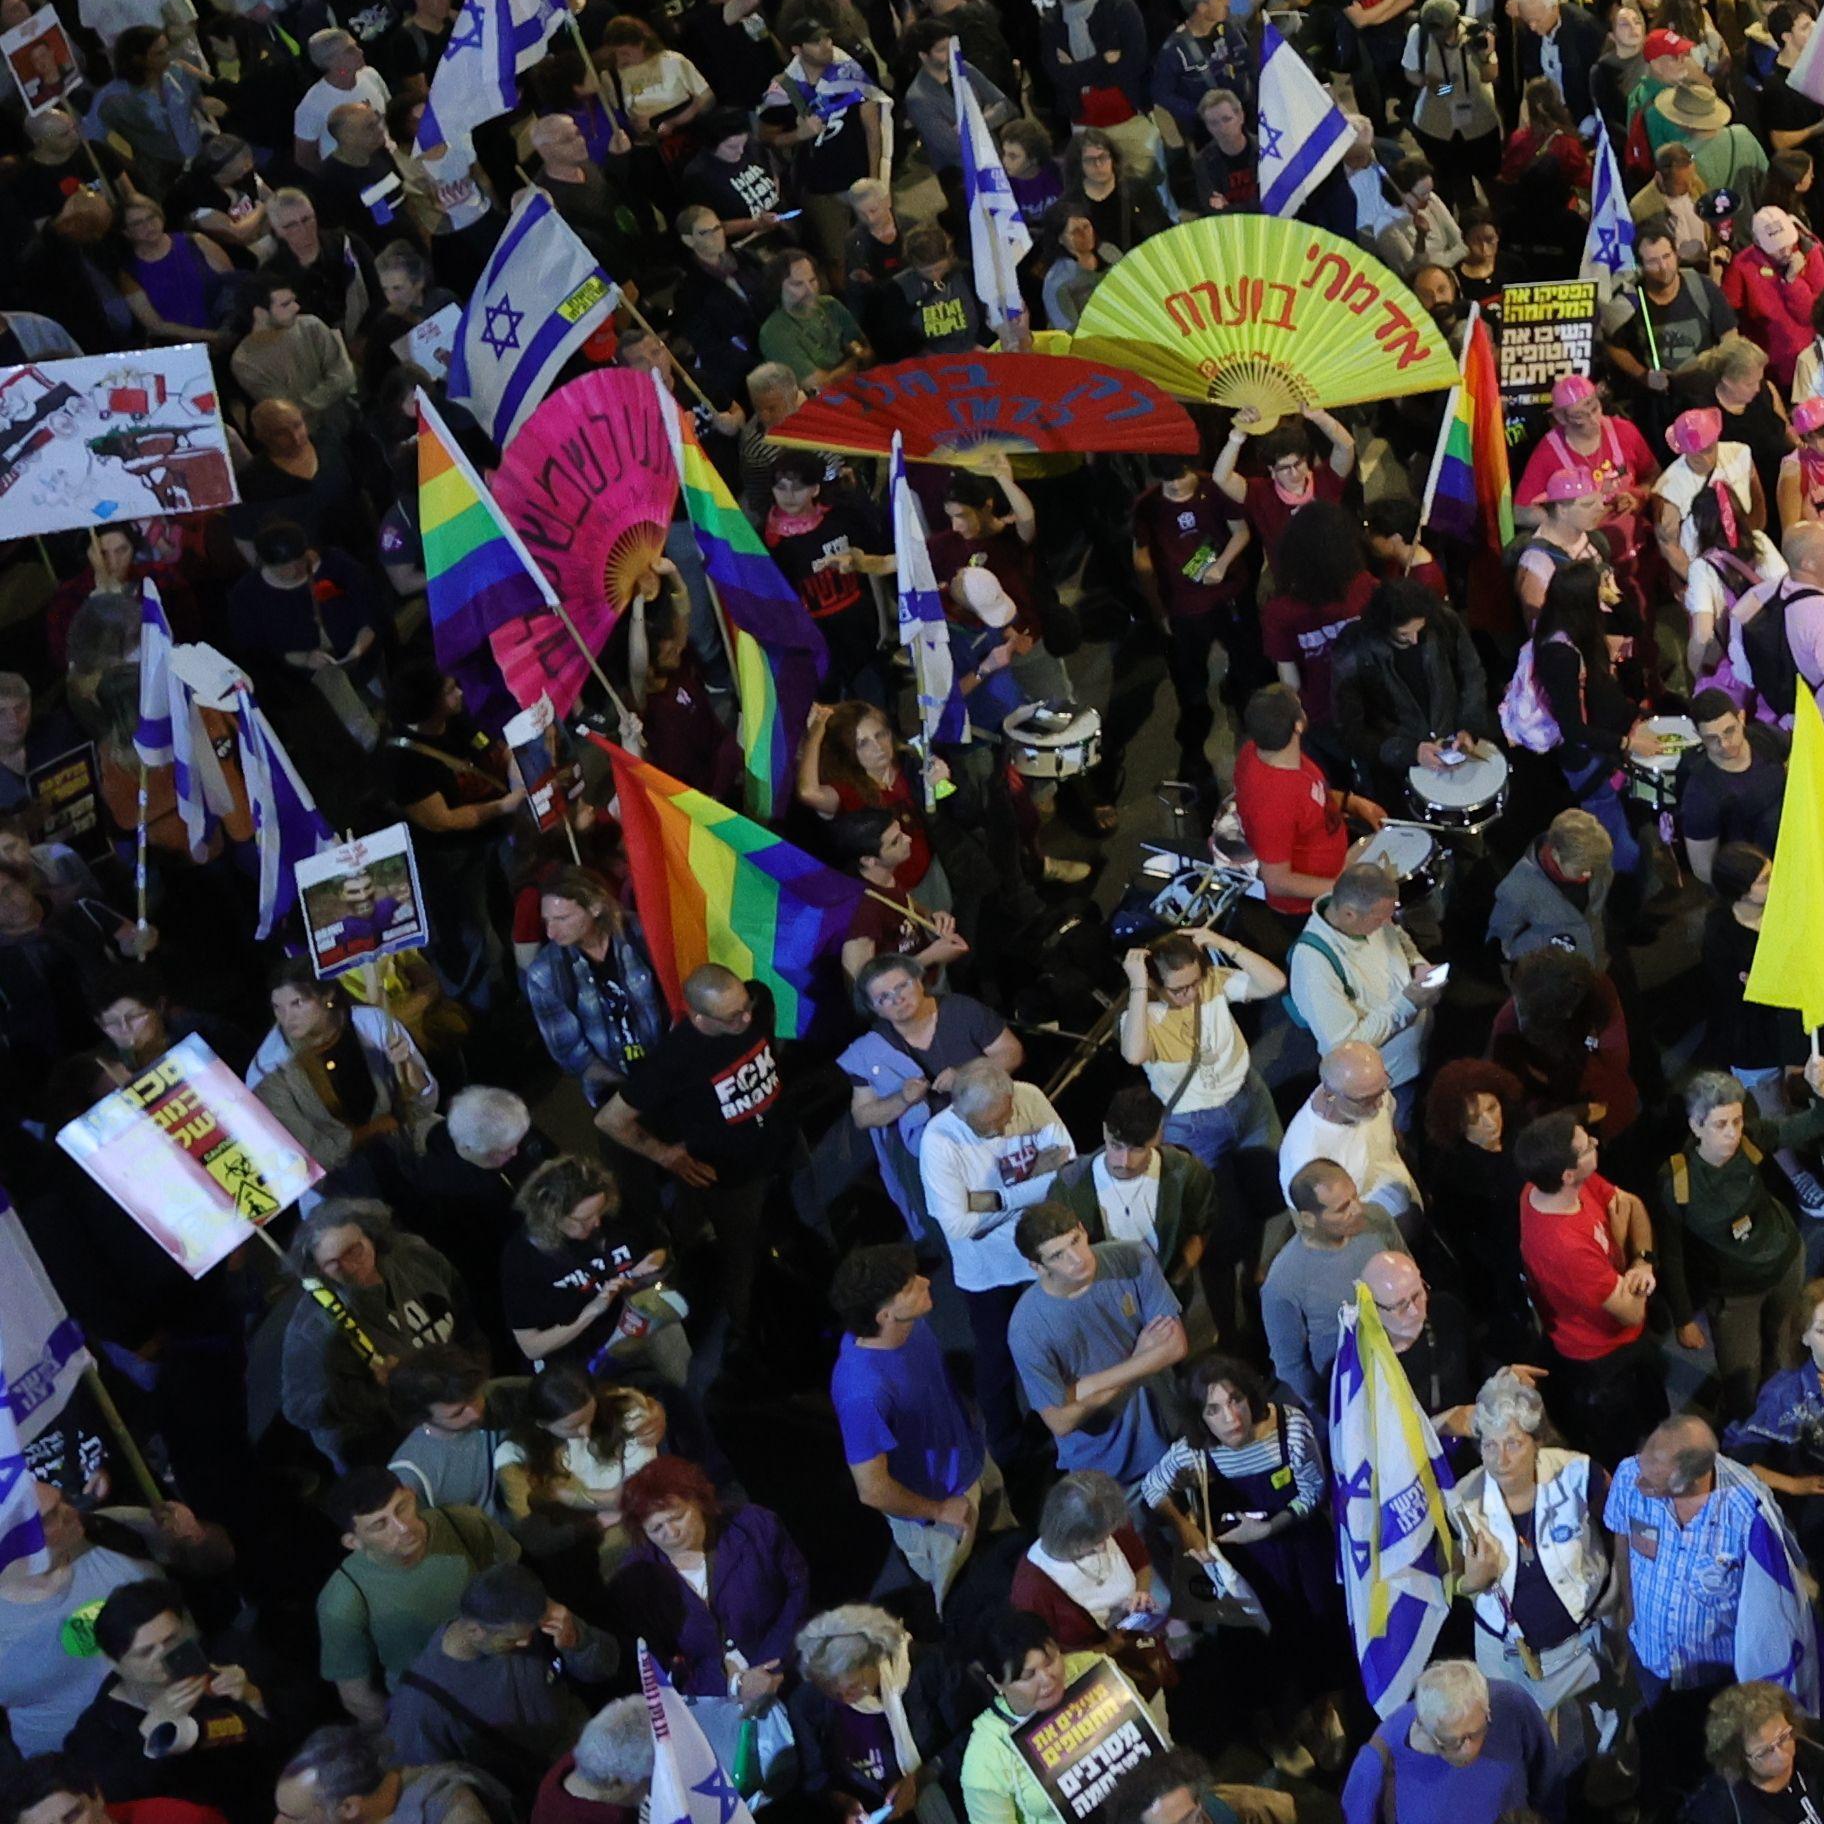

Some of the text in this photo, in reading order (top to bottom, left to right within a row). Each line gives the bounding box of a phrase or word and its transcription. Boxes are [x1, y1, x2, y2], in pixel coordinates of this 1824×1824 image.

[1300, 242, 1431, 370] אדמתי
[1502, 301, 1595, 327] המלחמה!
[1503, 282, 1595, 305] הפסיקו את
[1501, 322, 1593, 349] השיבו את
[1501, 341, 1593, 367] החטופים
[713, 1045, 776, 1105] FCK
[1031, 1682, 1110, 1754] מצילים את
[1040, 1696, 1121, 1770] החטופים
[1056, 1719, 1143, 1801] מסרבים
